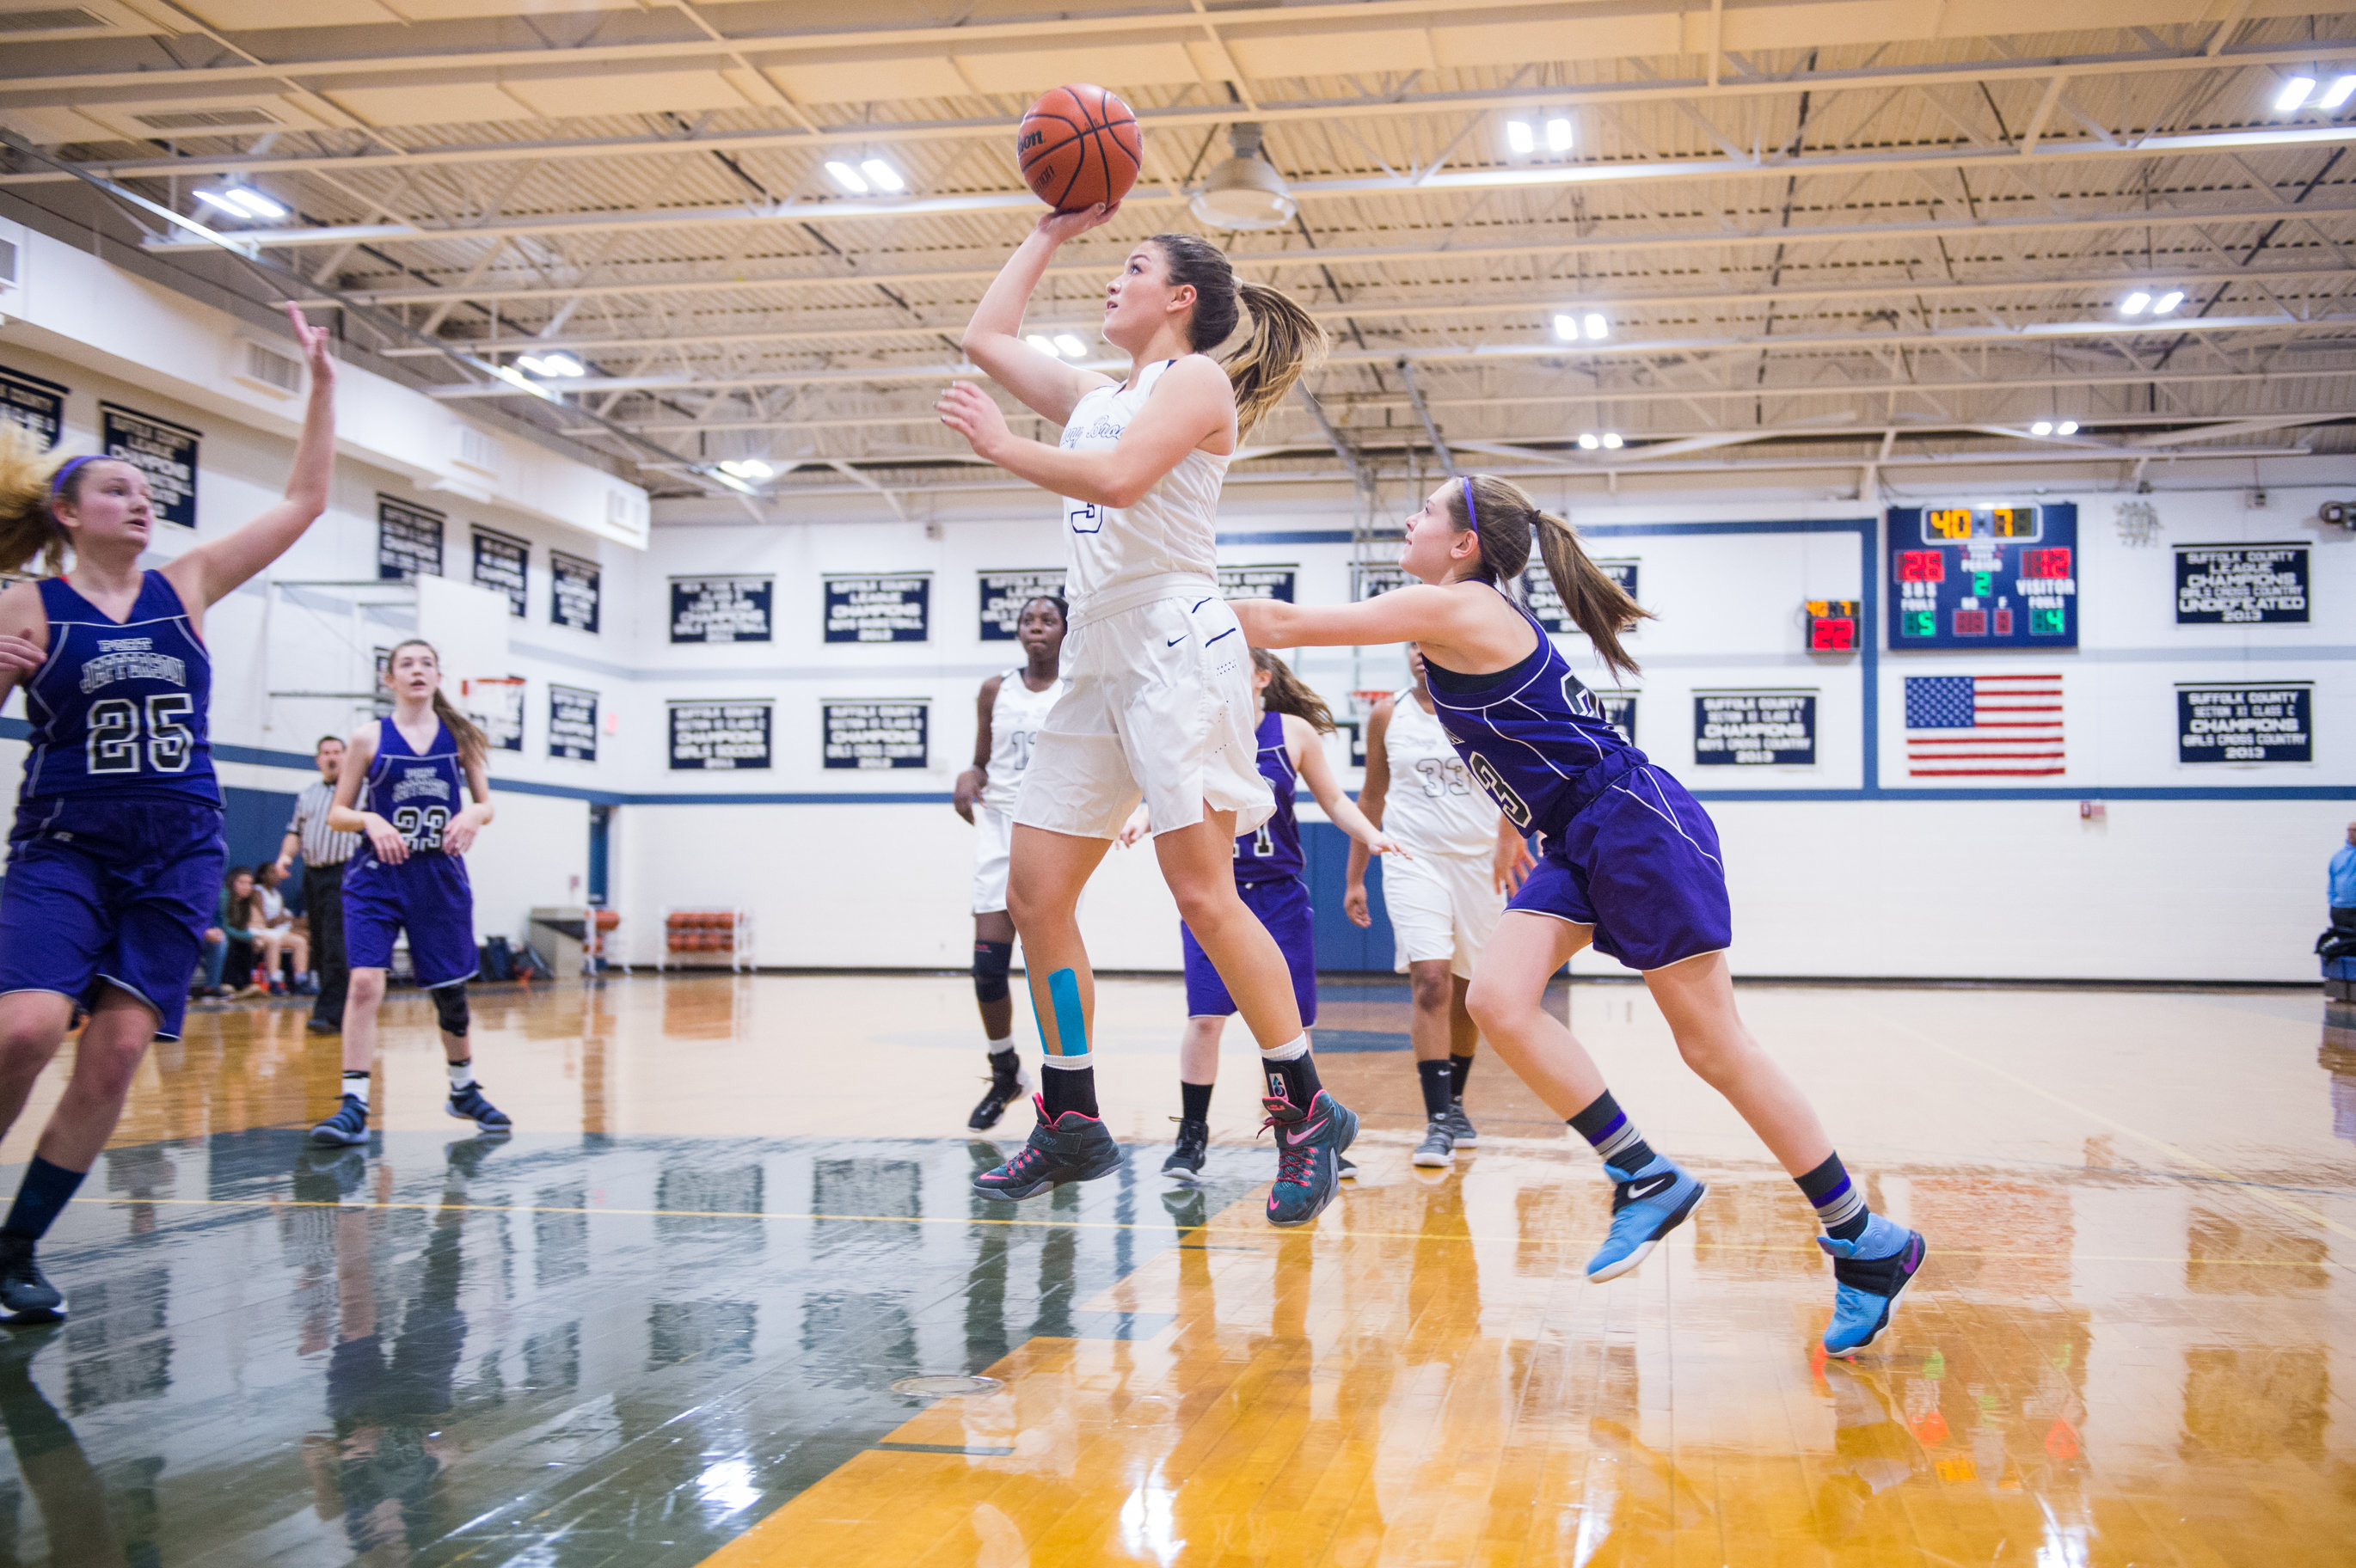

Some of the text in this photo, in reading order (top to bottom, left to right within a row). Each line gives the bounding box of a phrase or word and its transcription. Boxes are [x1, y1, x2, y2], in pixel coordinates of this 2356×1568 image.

[1930, 508, 2013, 539] 40 7
[2187, 551, 2296, 564] SUFFOLK COUNTY
[1903, 551, 1945, 583] 26
[2041, 548, 2071, 579] 12
[1961, 559, 2003, 573] PERIOD
[2209, 562, 2273, 574] LEAGUE
[831, 580, 921, 594] SUFFOLK COUNTY
[1973, 571, 1991, 597] 2
[2187, 573, 2297, 587] CHAMPIONS
[2016, 579, 2076, 597] VISITOR
[2180, 585, 2304, 598] GIRLS CROSS COUNTRY
[849, 592, 903, 604] LEAGUE
[1901, 598, 1936, 611] FOULS
[2029, 596, 2064, 609] FOULS
[2179, 597, 2305, 613] UNDEFEATED
[679, 609, 765, 623] CHAMPIONS
[831, 603, 921, 619] CHAMPIONS
[2222, 610, 2263, 622] 2013
[1917, 609, 2065, 636] 5 4
[1813, 618, 1854, 651] 22
[1703, 697, 1805, 711] SUFFOLK COUNTY
[2188, 691, 2298, 705] SUFFOLK COUNTY
[723, 707, 764, 718] COUNTY
[878, 706, 920, 718] COUNTY
[2193, 705, 2231, 718] SECTION
[2251, 704, 2283, 717] CLASS
[1704, 723, 1805, 738] CHAMPIONS
[2190, 718, 2299, 733] CHAMPIONS
[87, 693, 194, 775] 25
[676, 731, 764, 744] CHAMPIONS
[831, 730, 920, 744] CHAMPIONS
[2182, 732, 2307, 747] GIRLS CROSS COUNTRY
[1011, 730, 1037, 770] 1
[1727, 738, 1761, 751] CROSS
[1763, 738, 1811, 751] COUNTRY
[2225, 746, 2266, 759] 2013
[1416, 756, 1472, 798] 33
[393, 805, 452, 852] 23
